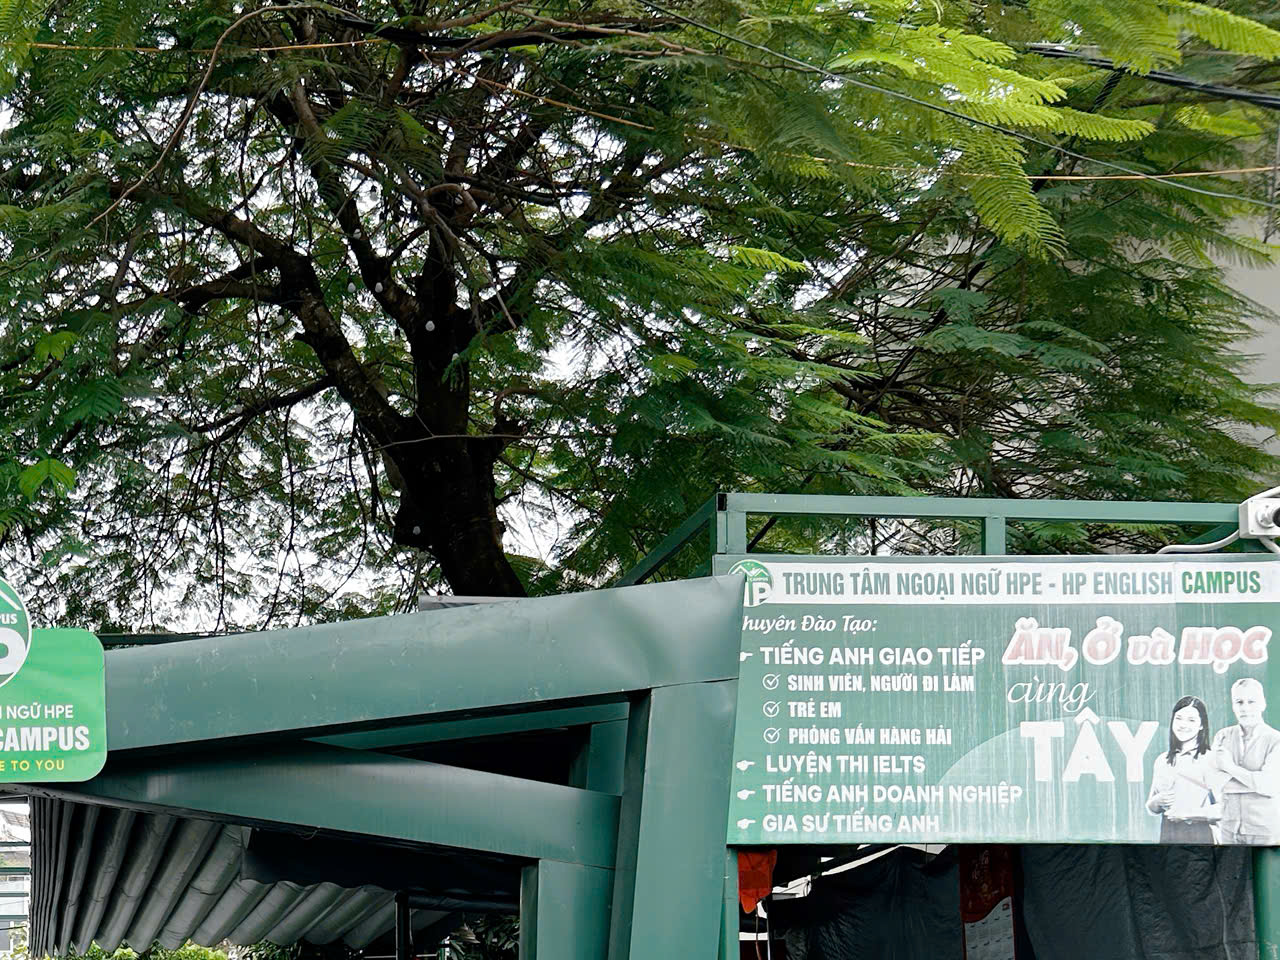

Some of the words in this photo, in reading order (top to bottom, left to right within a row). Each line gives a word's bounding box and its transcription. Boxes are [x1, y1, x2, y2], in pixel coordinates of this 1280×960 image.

[783, 572, 844, 595] TRUNG
[851, 568, 891, 595] TÂM
[897, 572, 955, 600] NGOẠI
[961, 568, 1002, 595] NGỮ
[1006, 572, 1042, 595] HPE
[1062, 573, 1087, 595] HP
[1093, 572, 1173, 595] ENGLISH
[1181, 571, 1261, 594] CAMPUS
[742, 614, 797, 634] huyên
[801, 615, 836, 631] Đào
[842, 615, 878, 634] Tạo:
[760, 639, 824, 665] TIẾNG
[829, 647, 873, 665] ANH
[879, 648, 933, 665] GIAO
[937, 640, 985, 665] TIẾP
[1127, 627, 1175, 665] và
[1179, 626, 1272, 673] HỌC
[787, 675, 824, 692] SINH
[828, 672, 866, 693] VIÊN,
[870, 672, 918, 692] NGƯỜI
[922, 675, 939, 692] ĐI
[943, 673, 975, 692] LÀM
[1007, 676, 1097, 713] cùng
[6, 703, 42, 720] NGỮ
[44, 705, 73, 719] HPE
[787, 698, 816, 718] TRẺ
[820, 702, 841, 718] EM
[789, 724, 840, 745] PHỎNG
[844, 723, 875, 745] VẤN
[879, 726, 920, 745] HÀNG
[925, 724, 952, 745] HẢI
[1020, 706, 1159, 782] TÂY
[11, 760, 30, 771] TO
[36, 759, 65, 771] YOU
[766, 751, 831, 778] LUYỆN
[836, 755, 868, 773] THI
[873, 755, 925, 773] IELTS
[762, 777, 822, 803] TIẾNG
[827, 784, 868, 803] ANH
[873, 784, 944, 803] DOANH
[949, 782, 1023, 809] NGHIỆP
[762, 814, 798, 833] GIA
[802, 812, 830, 833] SƯ
[832, 807, 892, 833] TIẾNG
[897, 815, 940, 833] ANH
